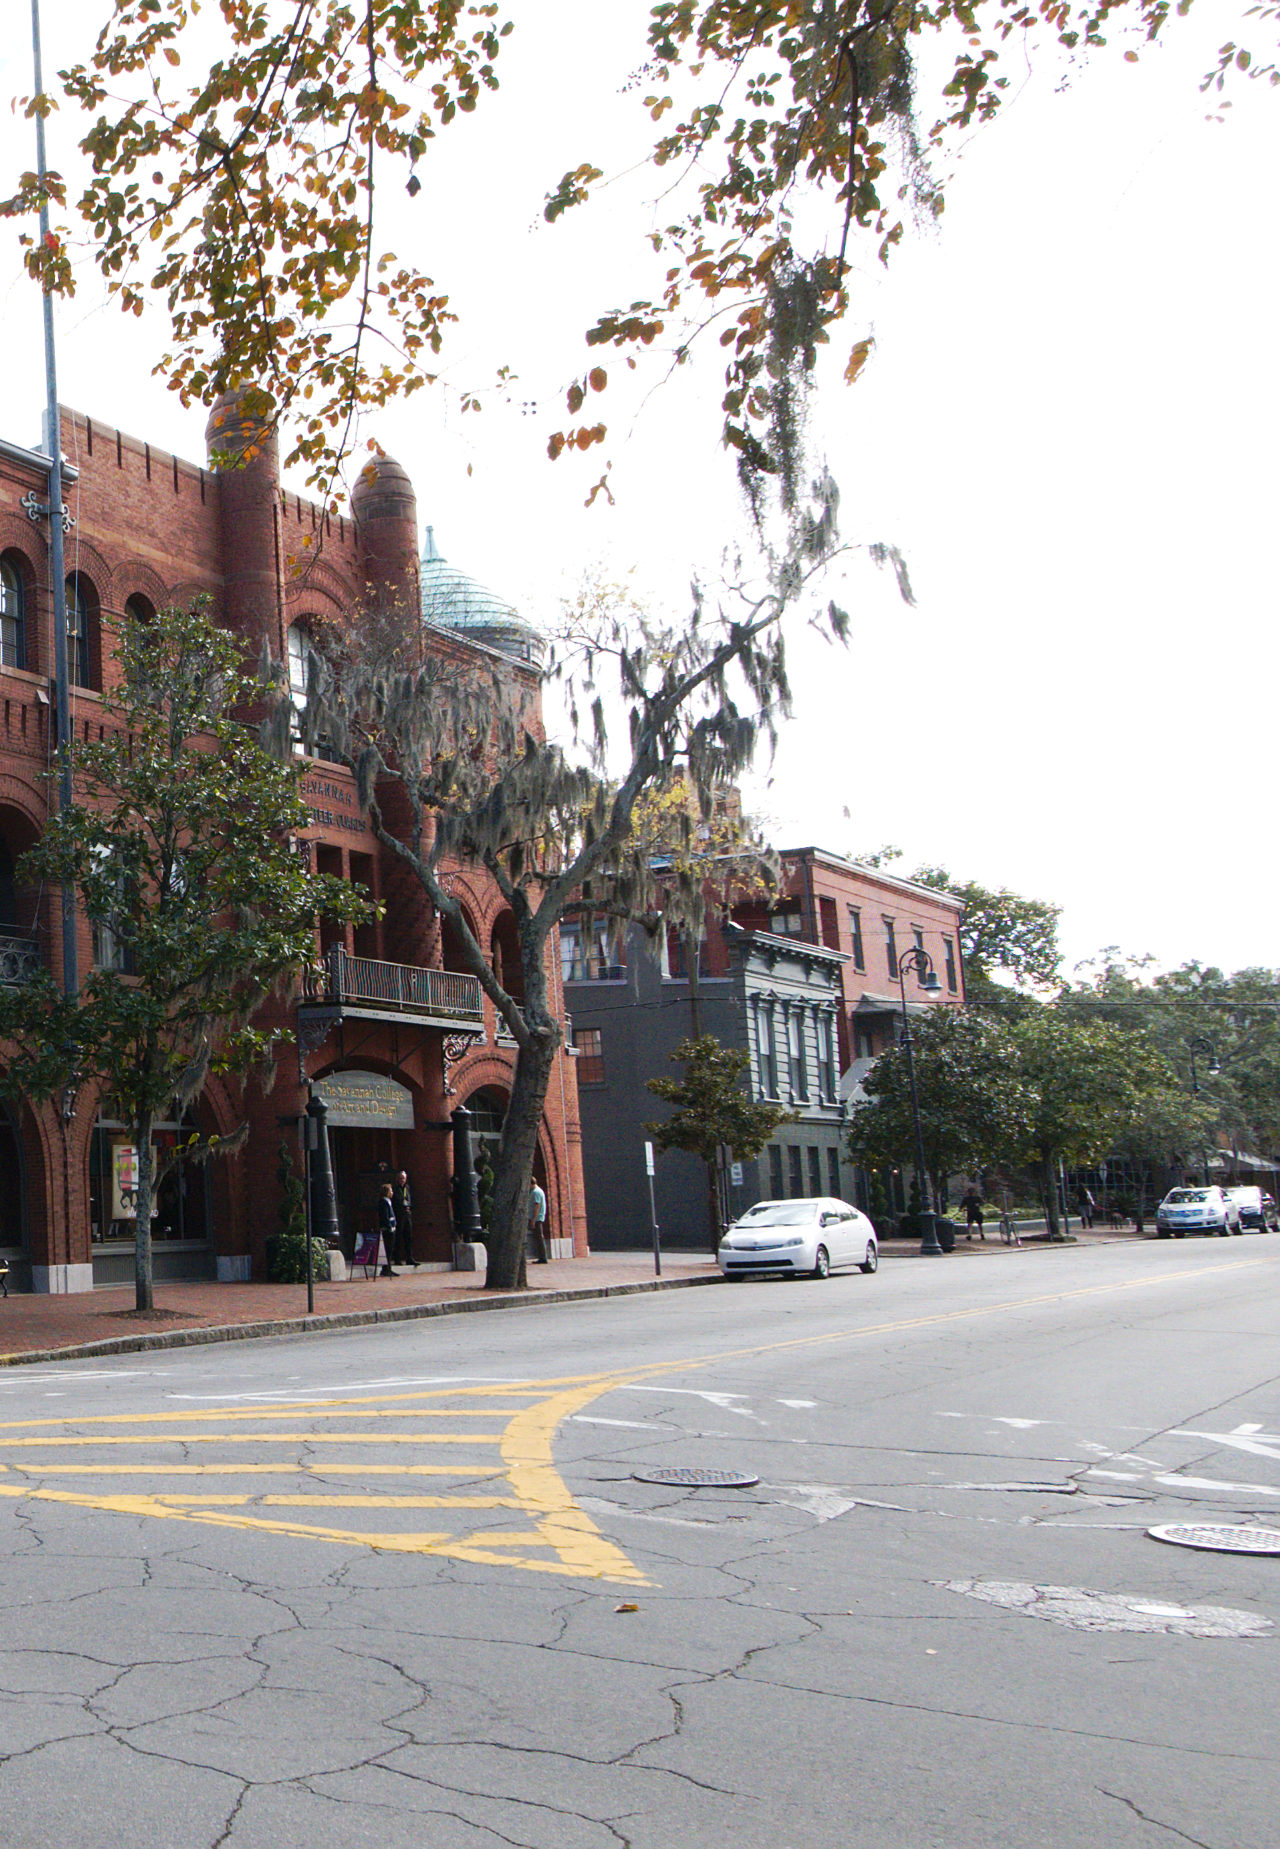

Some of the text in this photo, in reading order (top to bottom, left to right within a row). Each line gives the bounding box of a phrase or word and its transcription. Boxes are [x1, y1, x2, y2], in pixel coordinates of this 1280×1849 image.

[300, 780, 351, 805] SAVANNAH
[320, 1081, 404, 1103] The Savannah College
[372, 1100, 398, 1118] Design
